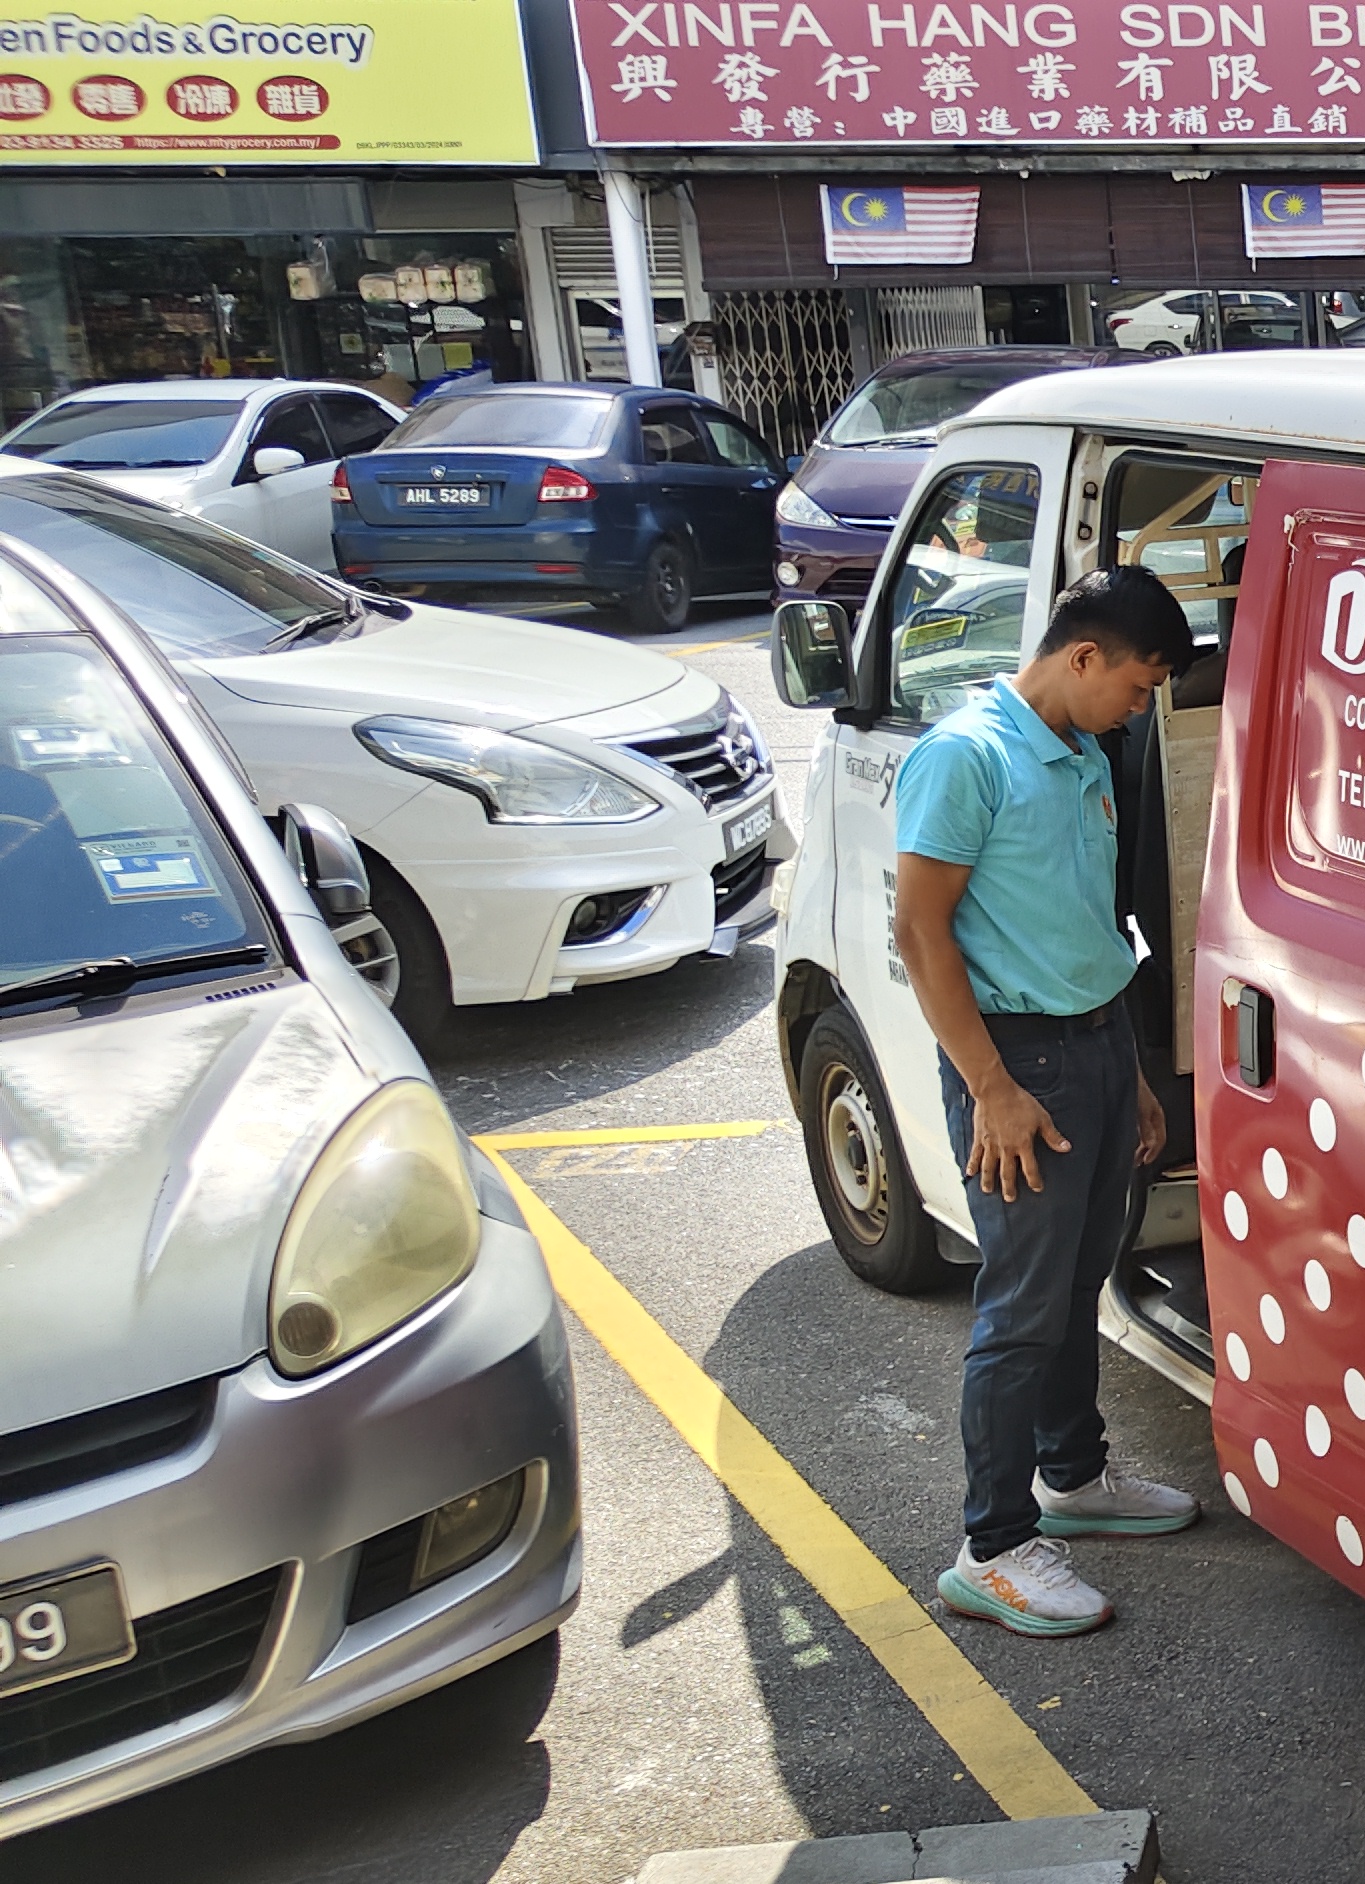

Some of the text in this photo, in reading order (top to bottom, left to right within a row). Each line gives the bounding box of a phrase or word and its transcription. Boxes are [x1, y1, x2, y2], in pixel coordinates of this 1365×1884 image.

[53, 22, 177, 55] Foods
[182, 33, 206, 55] &
[209, 23, 367, 63] Grocery
[611, 3, 834, 48] XINFA
[868, 3, 1077, 48] HANG
[1119, 3, 1267, 48] SDN
[174, 84, 233, 115] 冷凍
[265, 85, 322, 115] 雜貨
[406, 488, 480, 503] AHL 5289
[982, 1568, 1029, 1613] HOKA
[0, 1601, 67, 1673] 9
